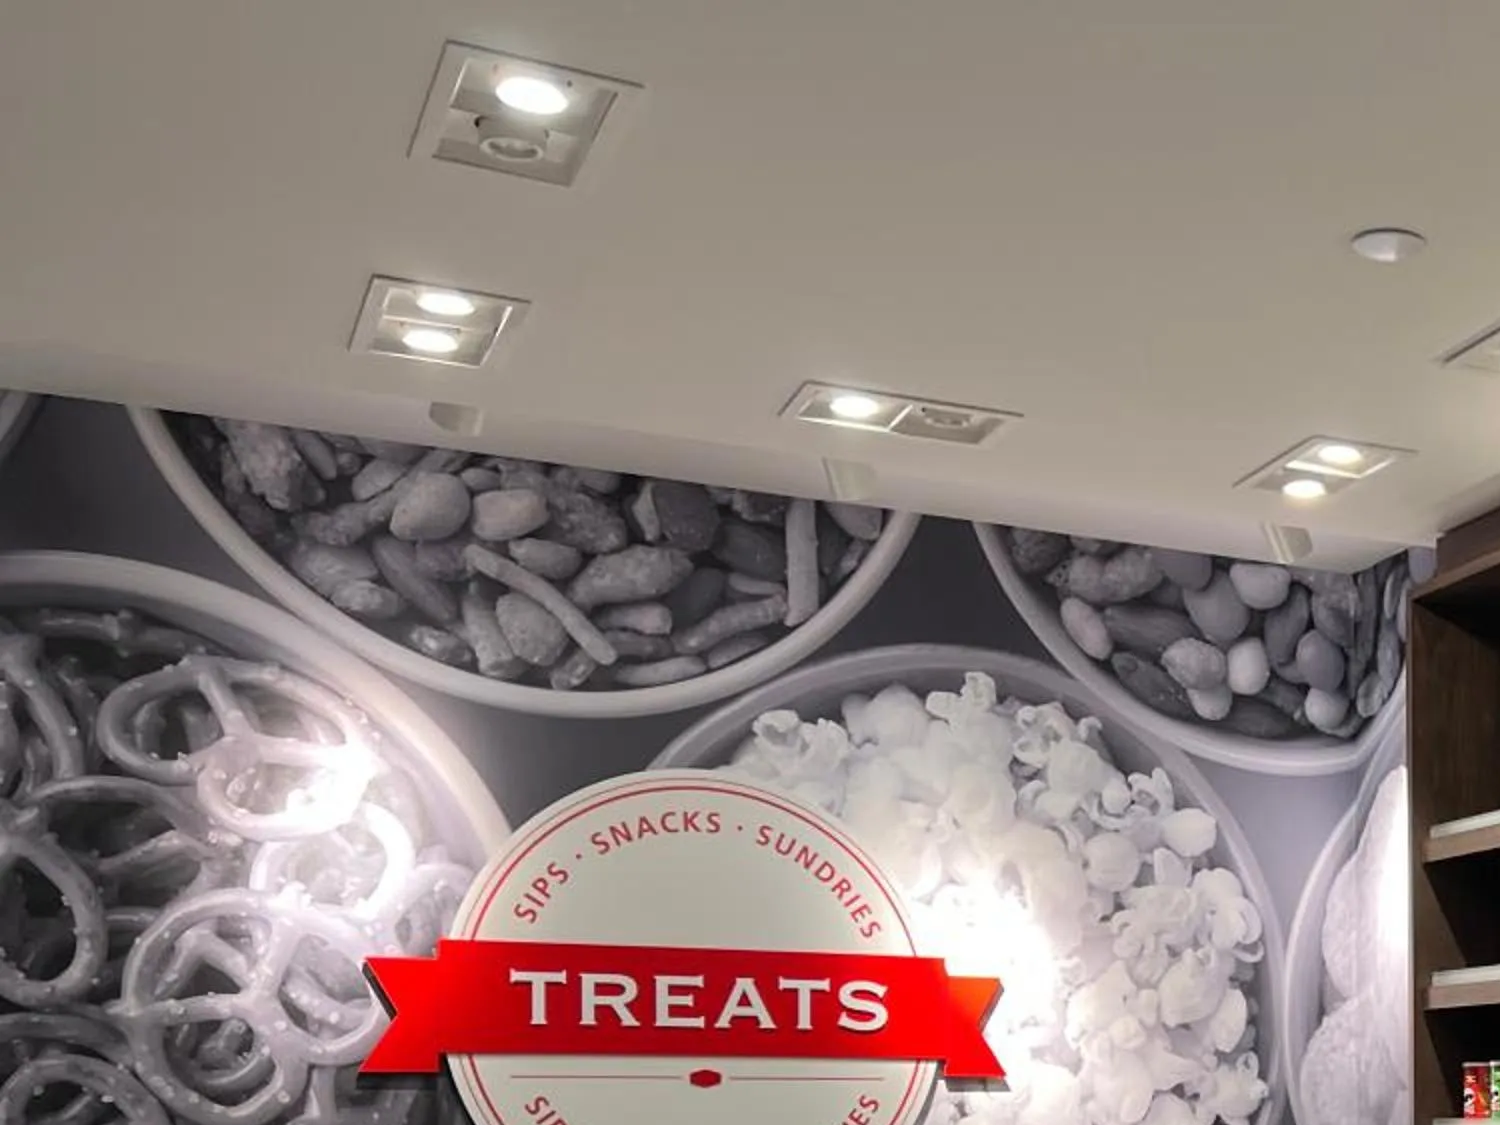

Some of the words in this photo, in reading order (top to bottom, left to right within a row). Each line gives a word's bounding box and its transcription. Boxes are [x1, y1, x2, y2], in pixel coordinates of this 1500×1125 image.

[513, 862, 570, 924] SIPS
[589, 810, 722, 856] SNACKS
[755, 824, 882, 940] SUNDRIES
[508, 968, 890, 1034] TREATS
